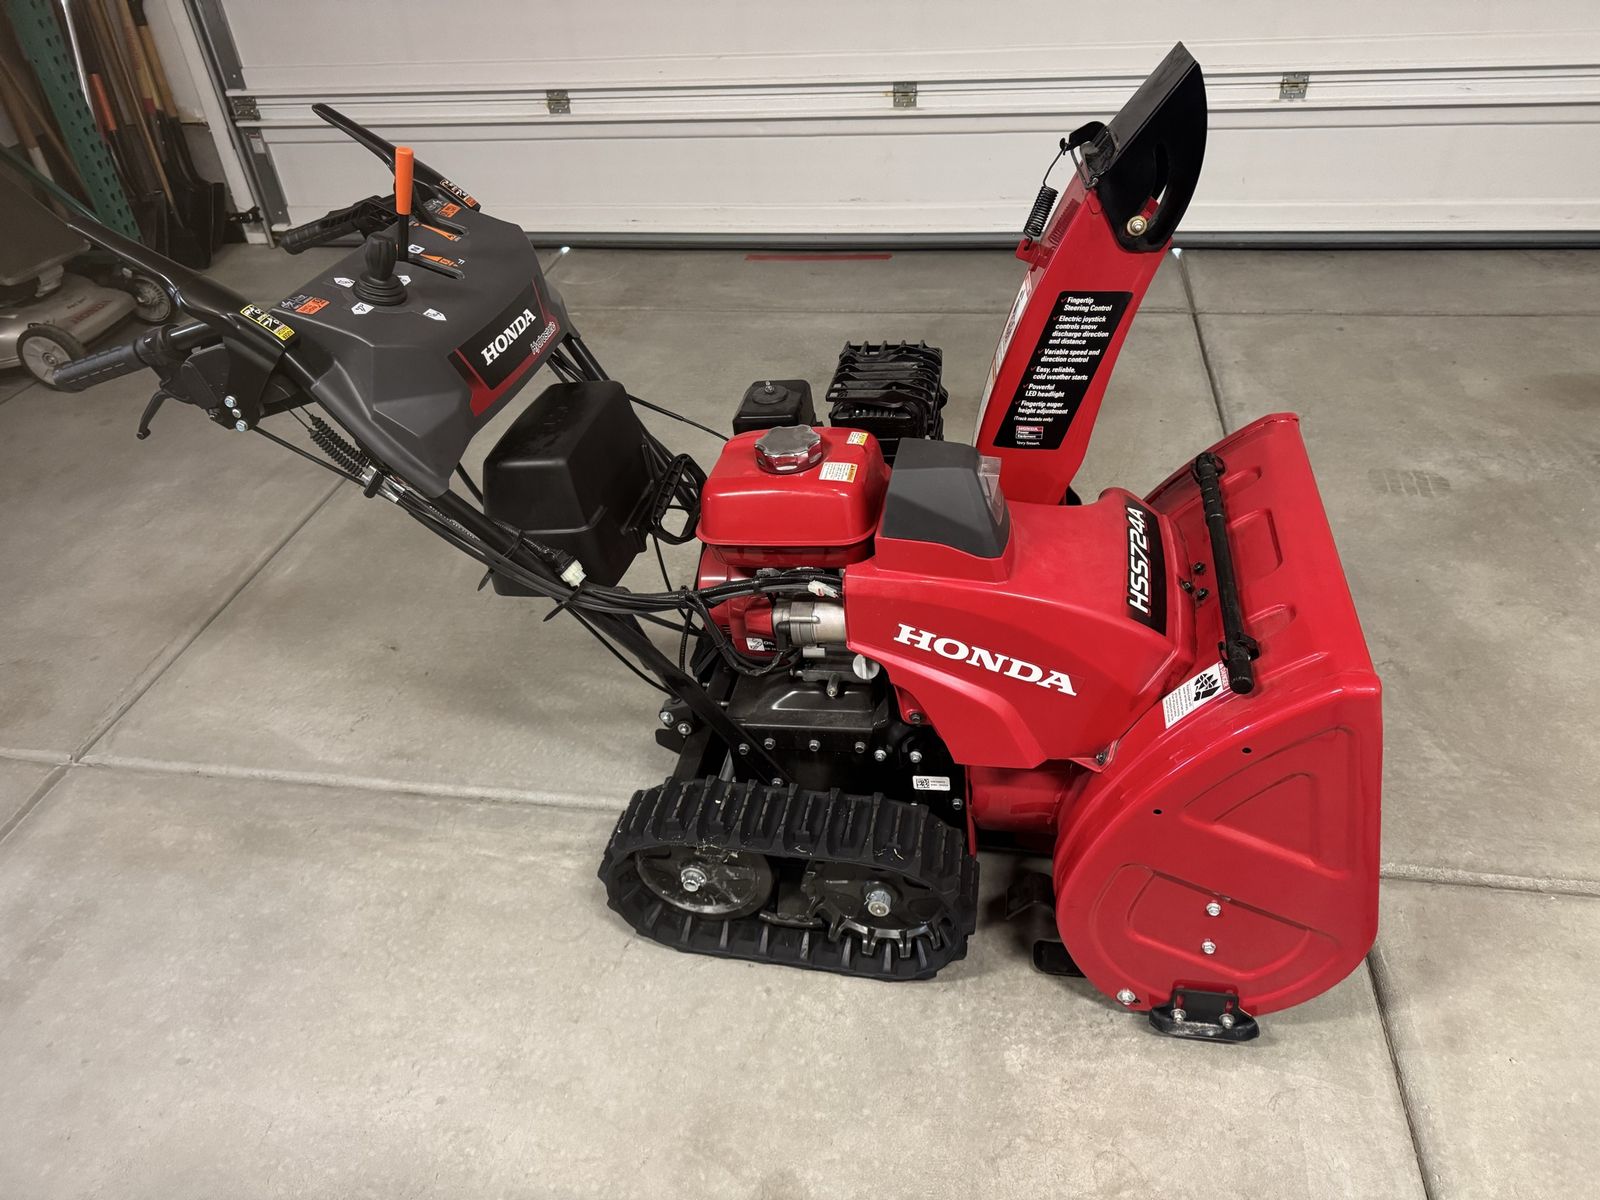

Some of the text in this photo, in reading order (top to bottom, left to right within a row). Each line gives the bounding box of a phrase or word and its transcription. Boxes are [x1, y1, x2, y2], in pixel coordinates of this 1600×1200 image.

[1082, 315, 1107, 323] joystick
[481, 309, 536, 366] HONDA
[1052, 330, 1082, 338] discharge
[1044, 348, 1069, 356] Variable
[1089, 348, 1100, 356] and
[1036, 366, 1051, 374] Easy,
[1021, 400, 1045, 408] Fingertip
[1129, 508, 1149, 613] HSS724A
[895, 624, 1077, 697] HONDA
